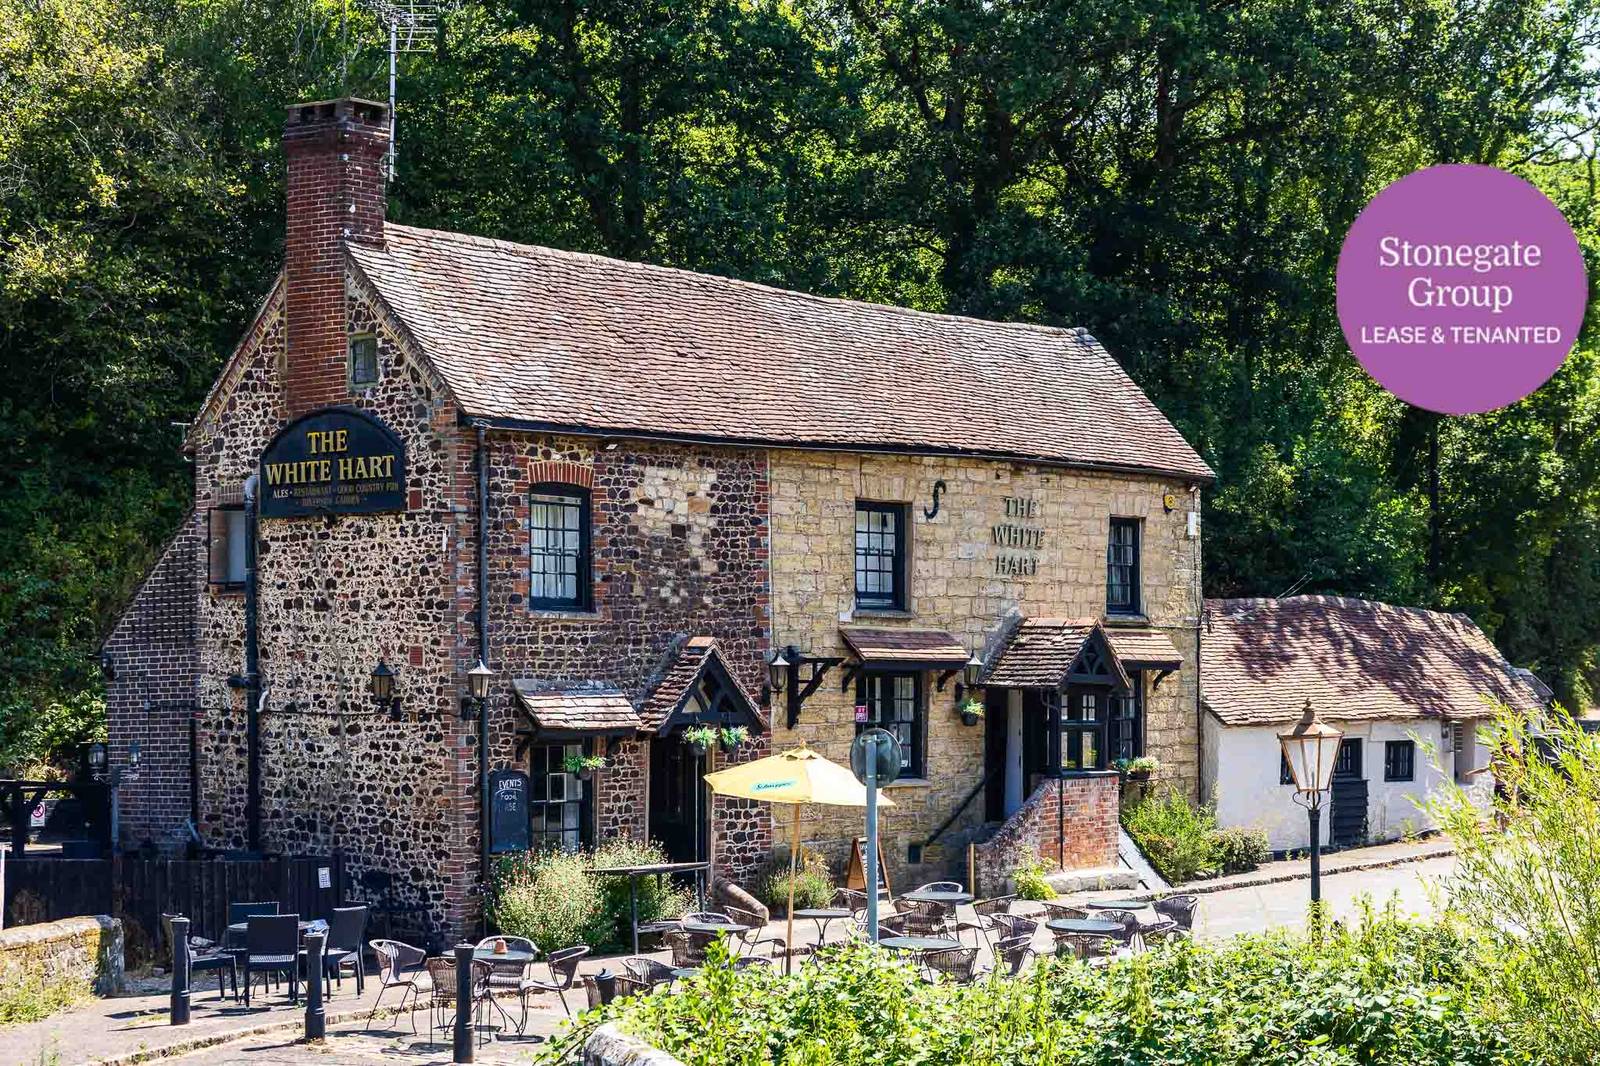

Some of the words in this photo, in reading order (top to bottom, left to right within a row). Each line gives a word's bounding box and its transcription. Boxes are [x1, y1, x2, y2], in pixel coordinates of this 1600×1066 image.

[306, 430, 348, 454] THE
[264, 460, 332, 485] WHITE
[338, 455, 395, 480] HART
[272, 489, 289, 498] ALES
[1005, 497, 1039, 518] THE
[992, 524, 1046, 549] WHITE
[995, 555, 1040, 576] HART
[498, 778, 523, 789] EVENTS
